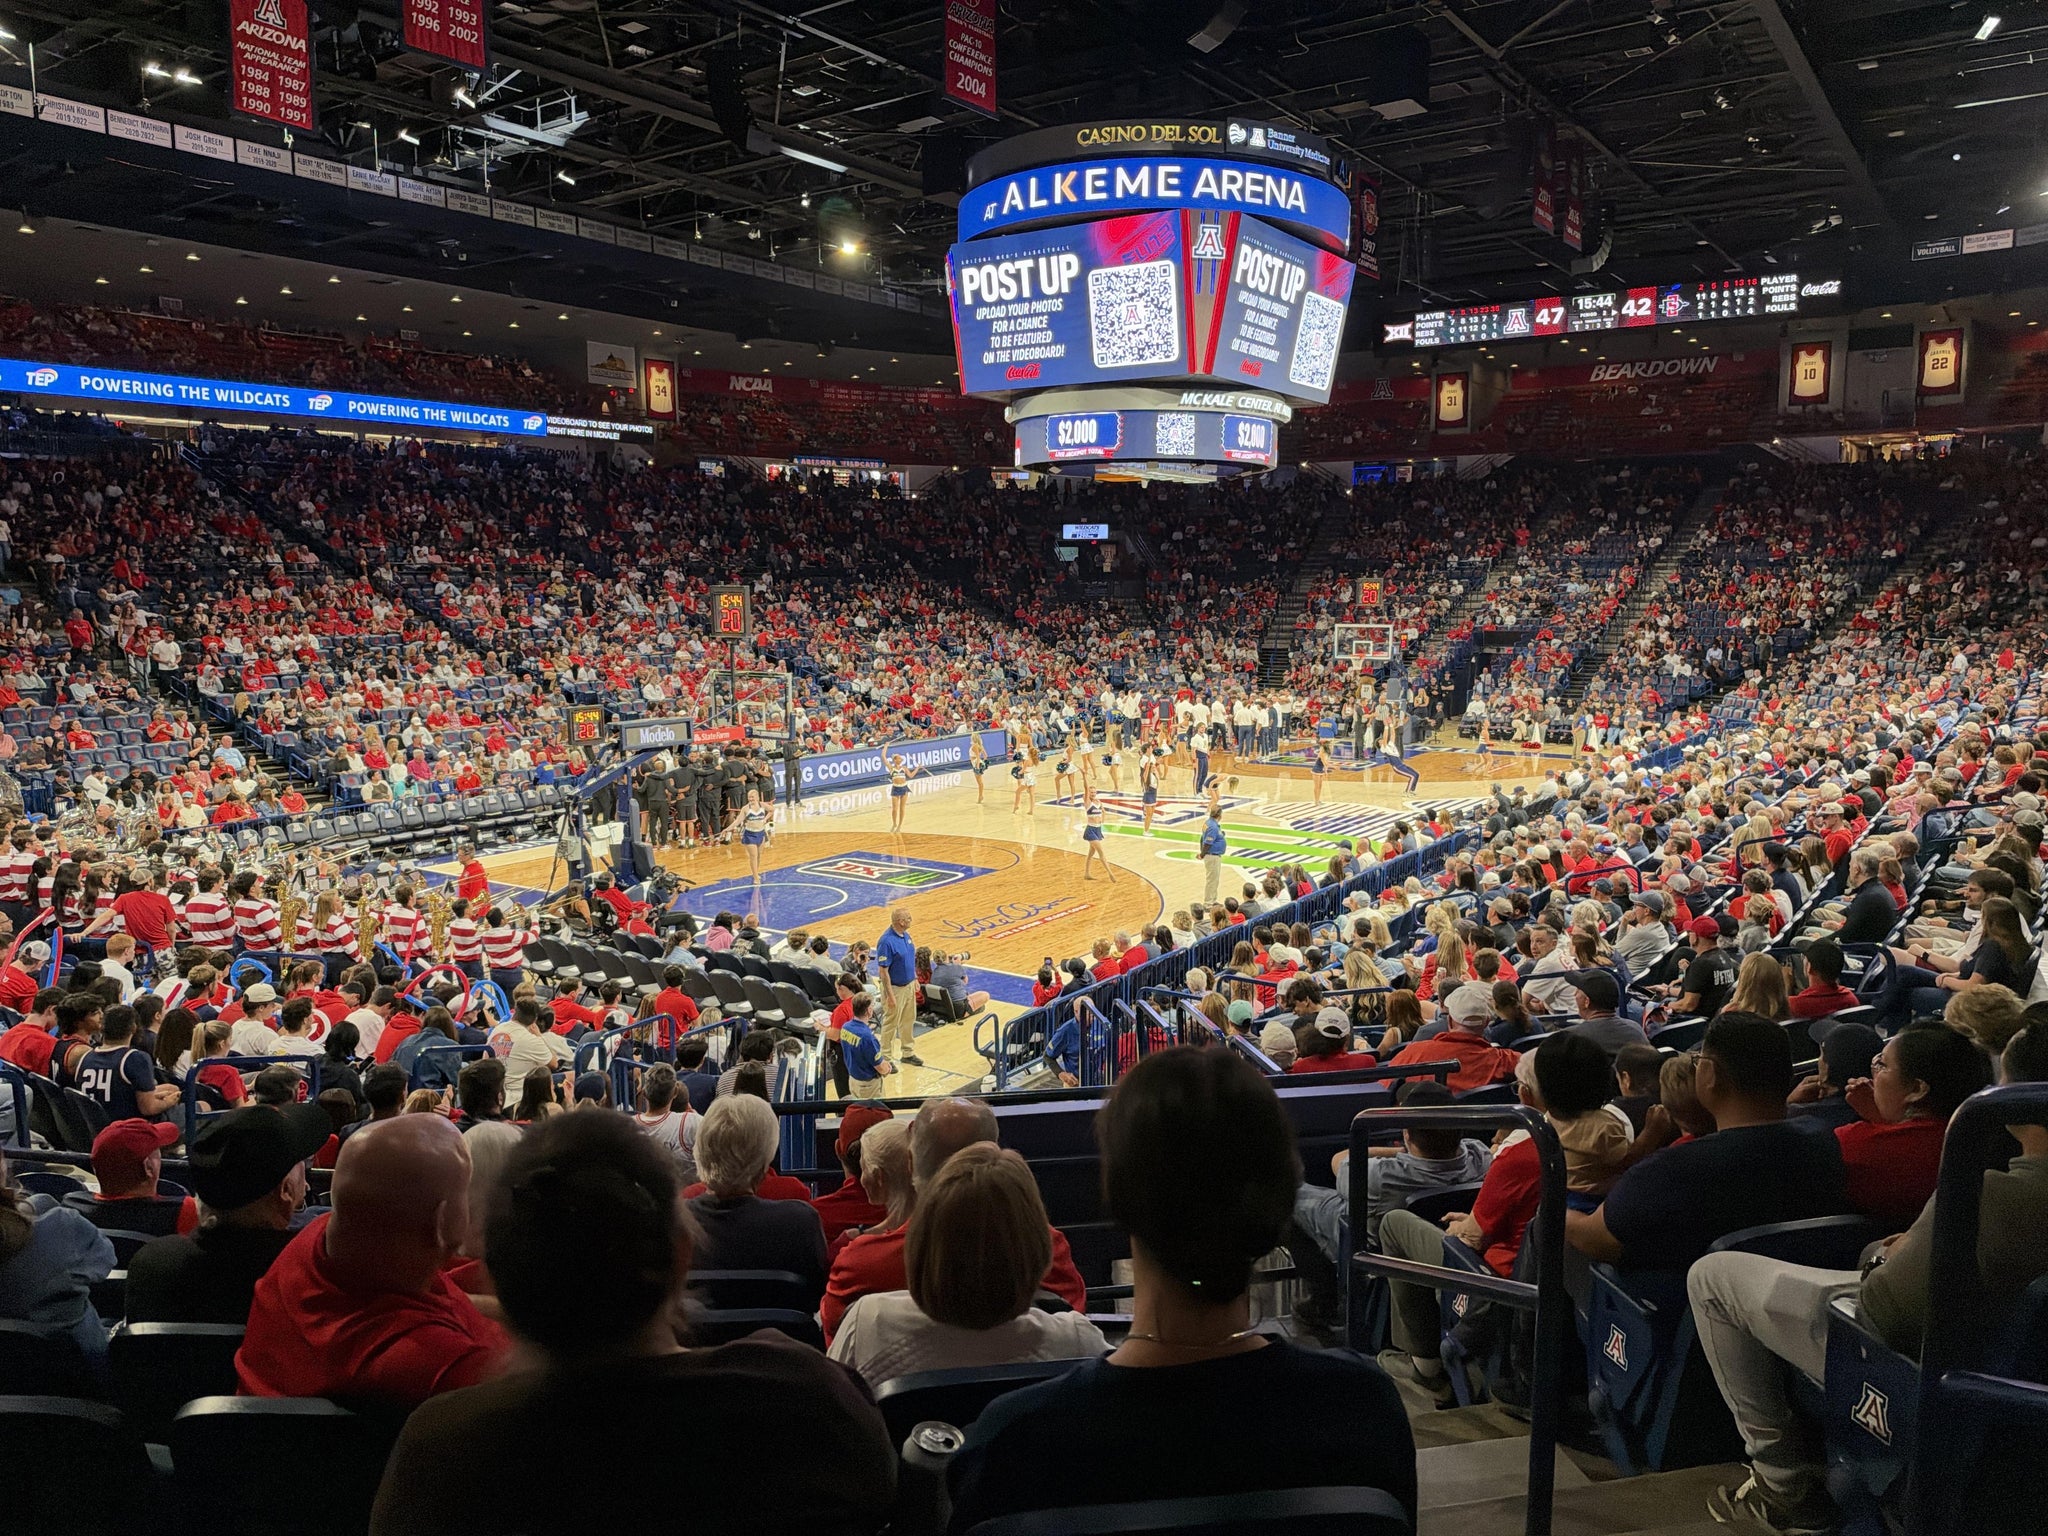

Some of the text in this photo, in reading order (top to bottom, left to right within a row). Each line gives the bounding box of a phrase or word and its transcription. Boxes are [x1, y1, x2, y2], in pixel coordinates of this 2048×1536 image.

[411, 0, 478, 26] 1992 1993
[947, 1, 995, 34] ARIZONA
[236, 20, 307, 53] ARIZONA
[411, 12, 479, 44] 1996 2002
[961, 33, 982, 49] PAC-10
[237, 41, 306, 69] NATIONAL TEAM
[948, 39, 993, 65] CONFERENCE
[243, 52, 300, 75] APPEARANCE
[949, 51, 993, 77] CHAMPIONS
[240, 65, 306, 92] 1984 1987
[956, 72, 987, 98] 2004
[240, 80, 307, 108] 1988 1989
[43, 98, 100, 119] CHRISTIAN KOLOKO
[241, 97, 307, 124] 1990 1991
[56, 112, 88, 126] 2019-2022
[110, 114, 139, 127] BENNEDICT
[125, 127, 155, 141] 2020-2022
[185, 131, 224, 147] JOSH GREEN
[1077, 125, 1222, 145] CASINO DEL SOL
[1267, 127, 1296, 143] Banner
[247, 145, 281, 159] ZEKE NNAJI
[1267, 139, 1331, 166] University Medicine
[297, 157, 313, 167] ALBERT
[352, 169, 368, 180] ERNIE
[983, 203, 998, 222] AT
[1002, 165, 1181, 215] ALKEME
[1192, 167, 1307, 214] ARENA
[961, 255, 991, 265] ARIZONA
[1023, 245, 1070, 258] BASKETBALL
[1362, 238, 1376, 254] 1997
[1916, 245, 1956, 256] VOLLEYBALL
[961, 253, 1079, 305] POST UP
[1235, 244, 1305, 304] POST UP
[1761, 275, 1797, 285] PLAYER
[1762, 284, 1797, 294] POINTS
[1772, 294, 1796, 302] REBS
[1801, 281, 1841, 297] Coca-Cola
[976, 298, 1063, 321] UPLOAD YOUR PHOTOS
[1238, 290, 1289, 318] UPLOAD YOUR PHOTOS
[1578, 296, 1613, 309] 15:44
[1621, 298, 1651, 316] 42
[1765, 303, 1796, 312] FOULS
[992, 315, 1048, 333] FOR A CHANCE
[1244, 309, 1278, 331] FOR CHANCE
[1416, 312, 1445, 321] PLAYER
[1416, 320, 1443, 329] POINTS
[1536, 307, 1564, 325] 47
[990, 331, 1052, 349] TO BE FEATURED
[1239, 324, 1247, 336] TO
[1253, 329, 1277, 346] FEATURED
[1415, 337, 1439, 346] FOULS
[983, 345, 1065, 365] ON THE VIDEOBOARD!
[1239, 340, 1249, 354] THE
[1932, 357, 1949, 371] 22
[1804, 368, 1817, 380] 10
[655, 385, 667, 397] 34
[729, 376, 773, 393] NCAA
[26, 369, 543, 430] TEP POWERING THE WILDCATS TEP POWERING THE WILDCATS TEP
[1237, 396, 1272, 412] CENTER
[1273, 402, 1283, 414] AT
[1447, 396, 1457, 407] 31
[546, 416, 653, 434] VIDEOBOARD TO SEE YOUR PHOTOS
[547, 426, 567, 435] RIGHT
[567, 428, 585, 437] HERE
[593, 431, 620, 440] MCKALE!
[1058, 418, 1098, 445] $2,000
[1238, 421, 1266, 449] $2,000
[1088, 448, 1104, 456] TOTAL
[801, 458, 880, 468] ARIZONA WILDCATS
[1363, 582, 1380, 590] 15:44
[720, 594, 742, 607] 15:44
[1362, 590, 1377, 603] 20
[720, 608, 741, 632] 20
[575, 711, 599, 723] 15:44
[578, 723, 595, 738] 20
[640, 728, 675, 744] Modelo
[818, 756, 882, 779] COOLING
[900, 746, 962, 769] PLUMBING
[81, 1069, 113, 1102] 24
[1851, 1381, 1892, 1445] A
